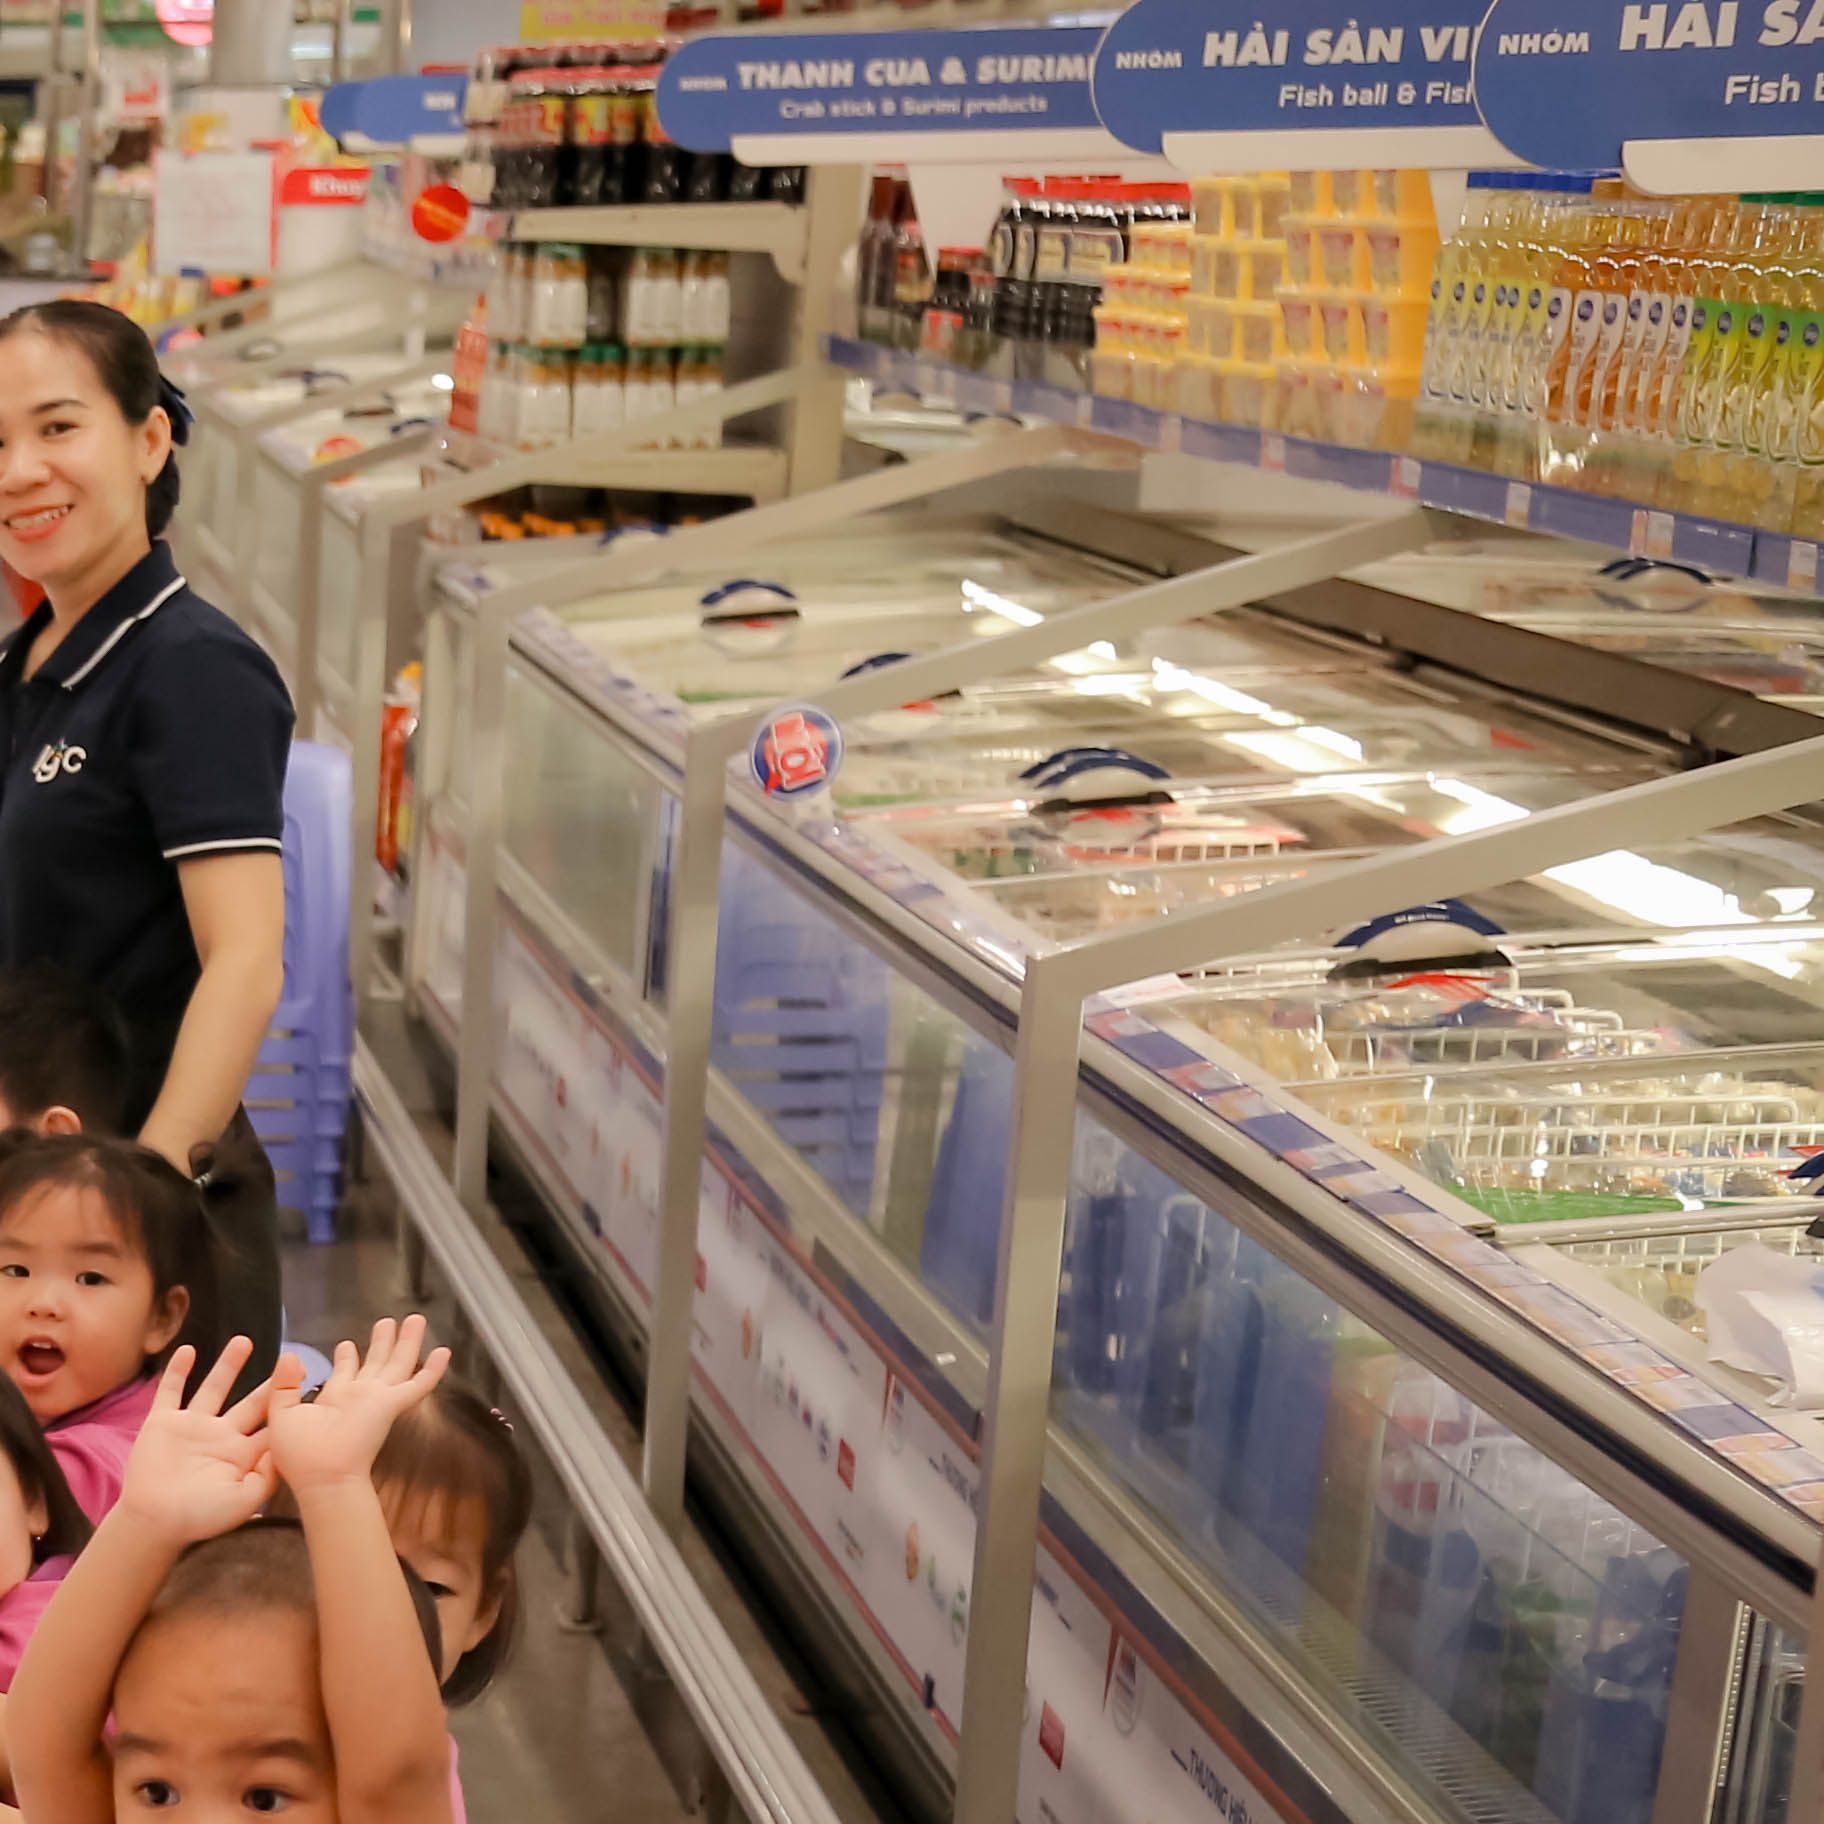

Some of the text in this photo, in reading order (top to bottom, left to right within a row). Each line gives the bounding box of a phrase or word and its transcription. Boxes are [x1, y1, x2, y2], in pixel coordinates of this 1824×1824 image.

[1203, 25, 1287, 67] HẢI
[1304, 20, 1404, 65] SẢN
[1497, 31, 1589, 56] NHÓM
[1116, 50, 1183, 70] NHÓM
[737, 61, 854, 90] THANH
[864, 58, 931, 87] CUA
[1278, 84, 1334, 109] Fish
[1344, 82, 1388, 106] ball
[1397, 82, 1417, 105] &
[1725, 73, 1800, 106] Fish
[963, 93, 1049, 119] products
